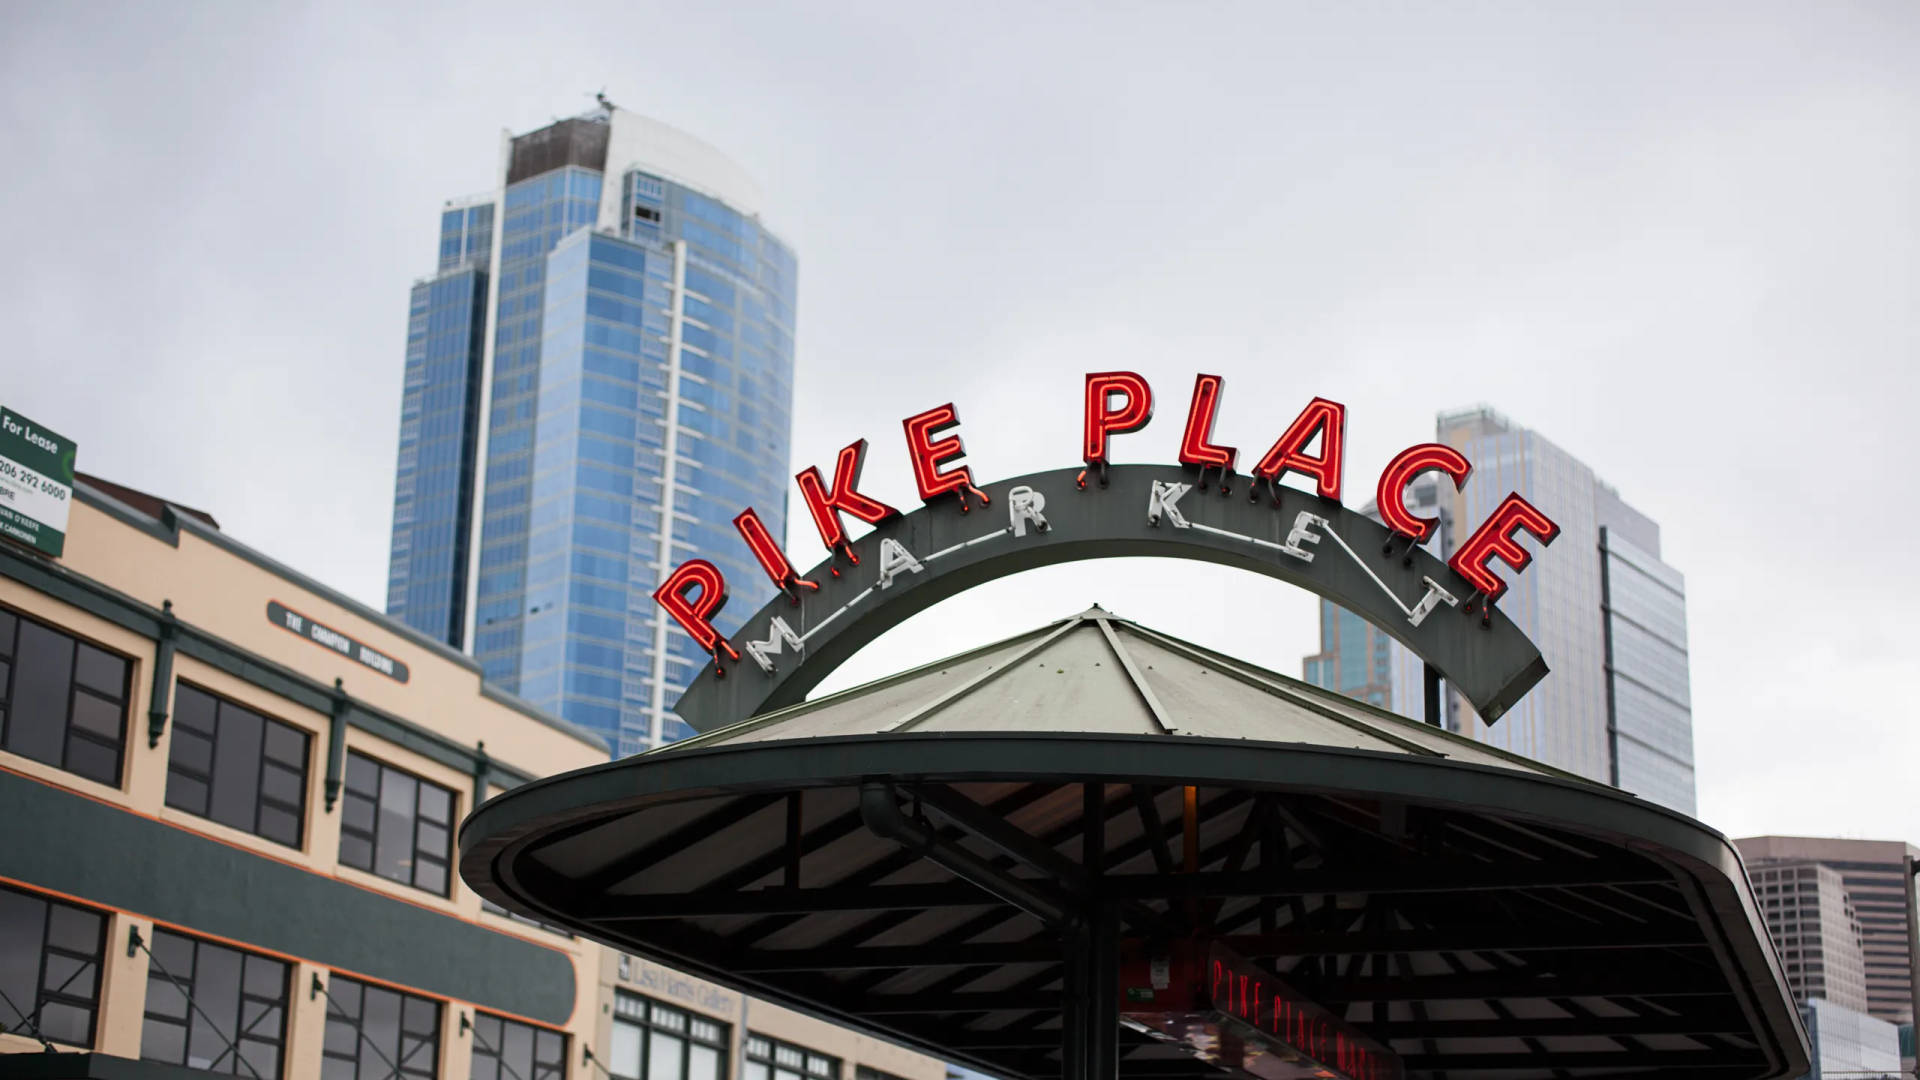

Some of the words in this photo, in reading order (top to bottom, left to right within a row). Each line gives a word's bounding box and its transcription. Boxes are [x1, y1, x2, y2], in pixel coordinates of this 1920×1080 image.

[3, 415, 22, 436] For
[25, 426, 58, 454] Lease
[0, 460, 16, 478] 206
[20, 470, 38, 488] 292
[41, 480, 65, 501] 6000
[653, 402, 971, 654] PIKE
[1084, 371, 1561, 600] PLACE
[745, 479, 1459, 674] MARKET
[286, 611, 303, 633] THE
[1212, 959, 1261, 1026] PIKE
